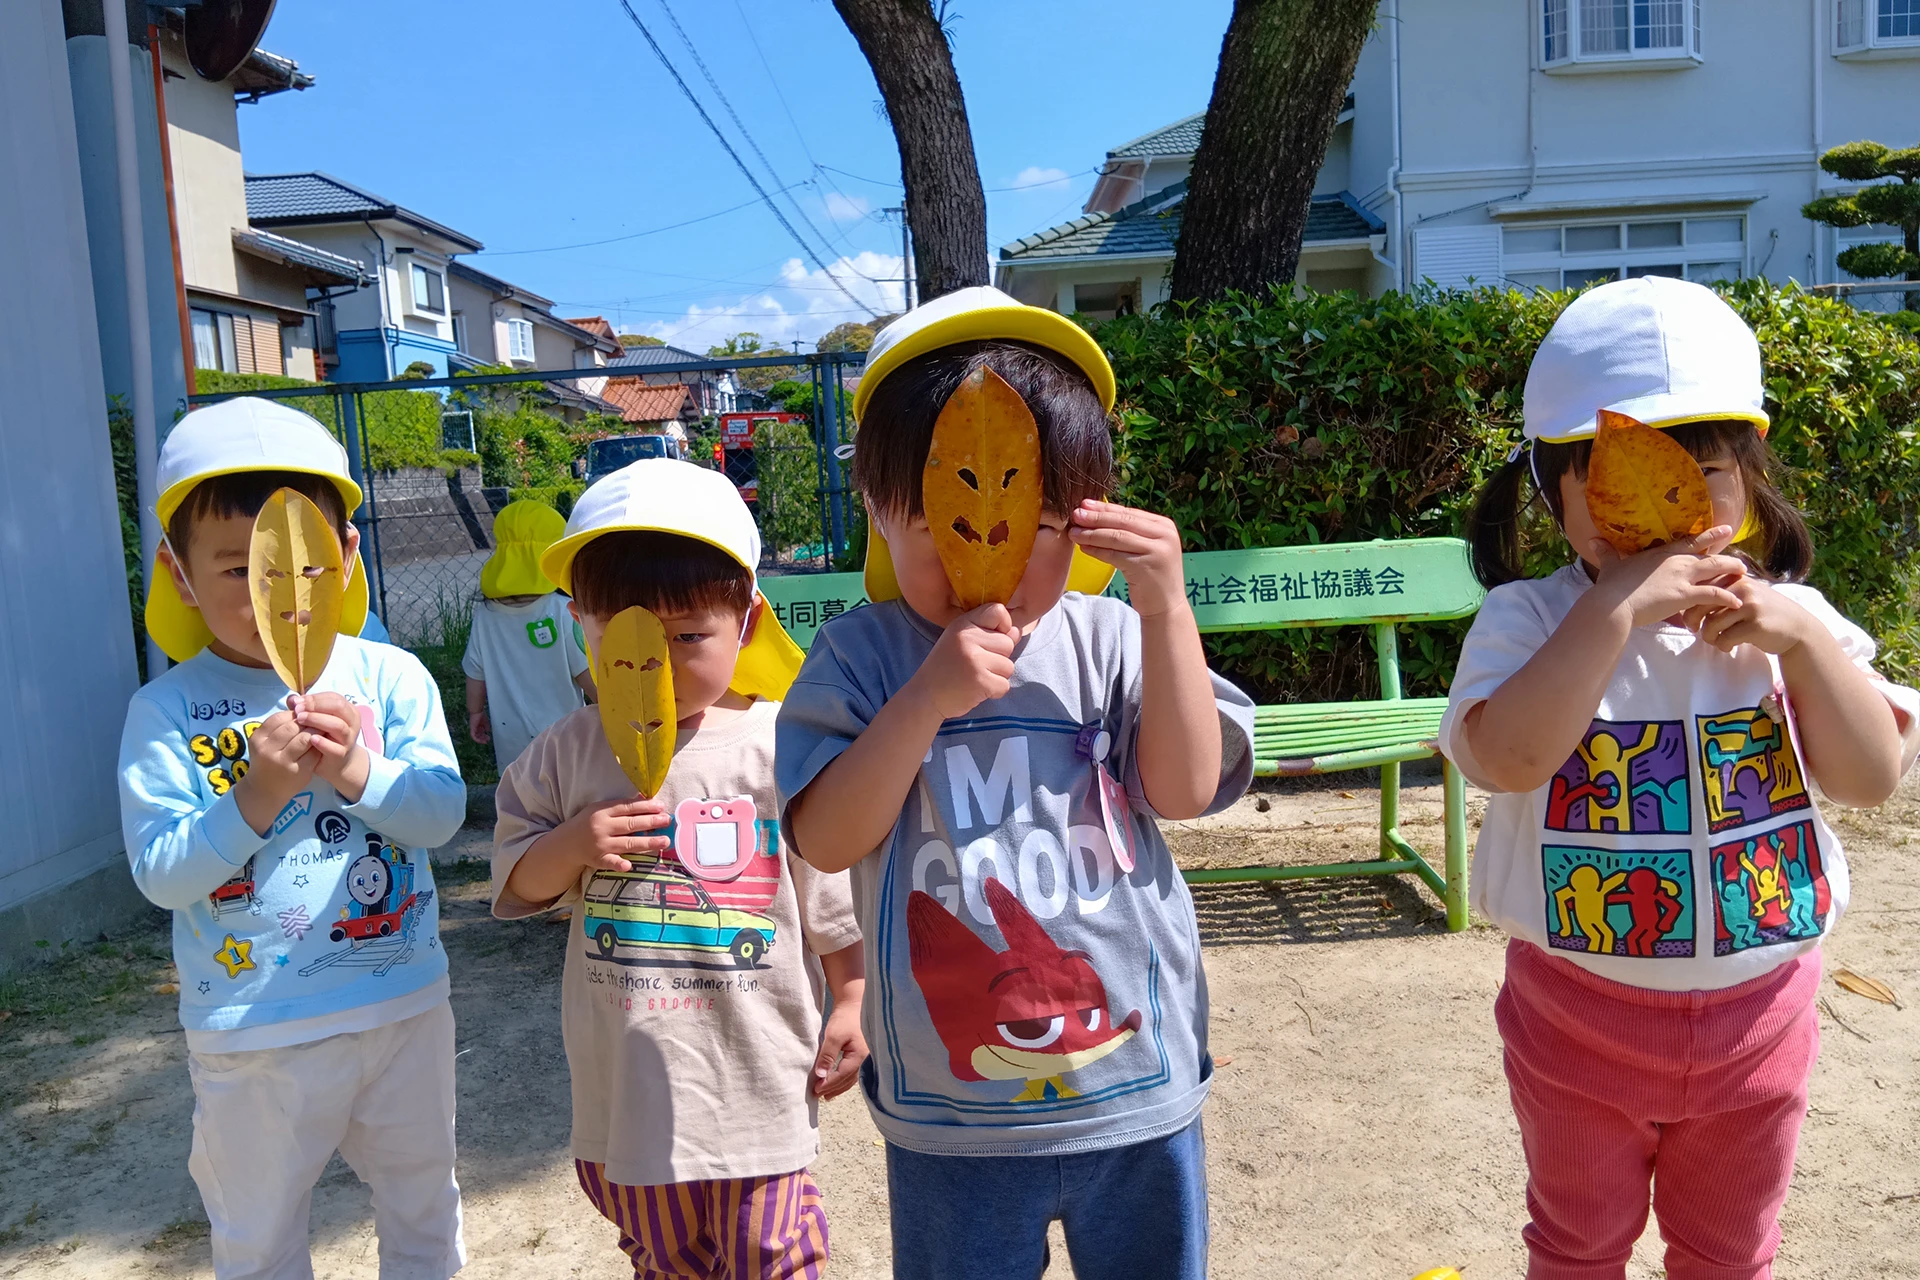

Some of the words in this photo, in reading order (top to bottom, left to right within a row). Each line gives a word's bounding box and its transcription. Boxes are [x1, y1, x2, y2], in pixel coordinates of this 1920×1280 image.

[1186, 566, 1405, 608] 社会福祉協議会
[772, 597, 872, 630] 共同募
[190, 699, 247, 720] 1945
[278, 849, 344, 868] THOMAS
[912, 824, 1115, 925] GOOD
[586, 964, 604, 984] ide
[671, 976, 733, 992] summer
[648, 997, 715, 1011] GROOVE
